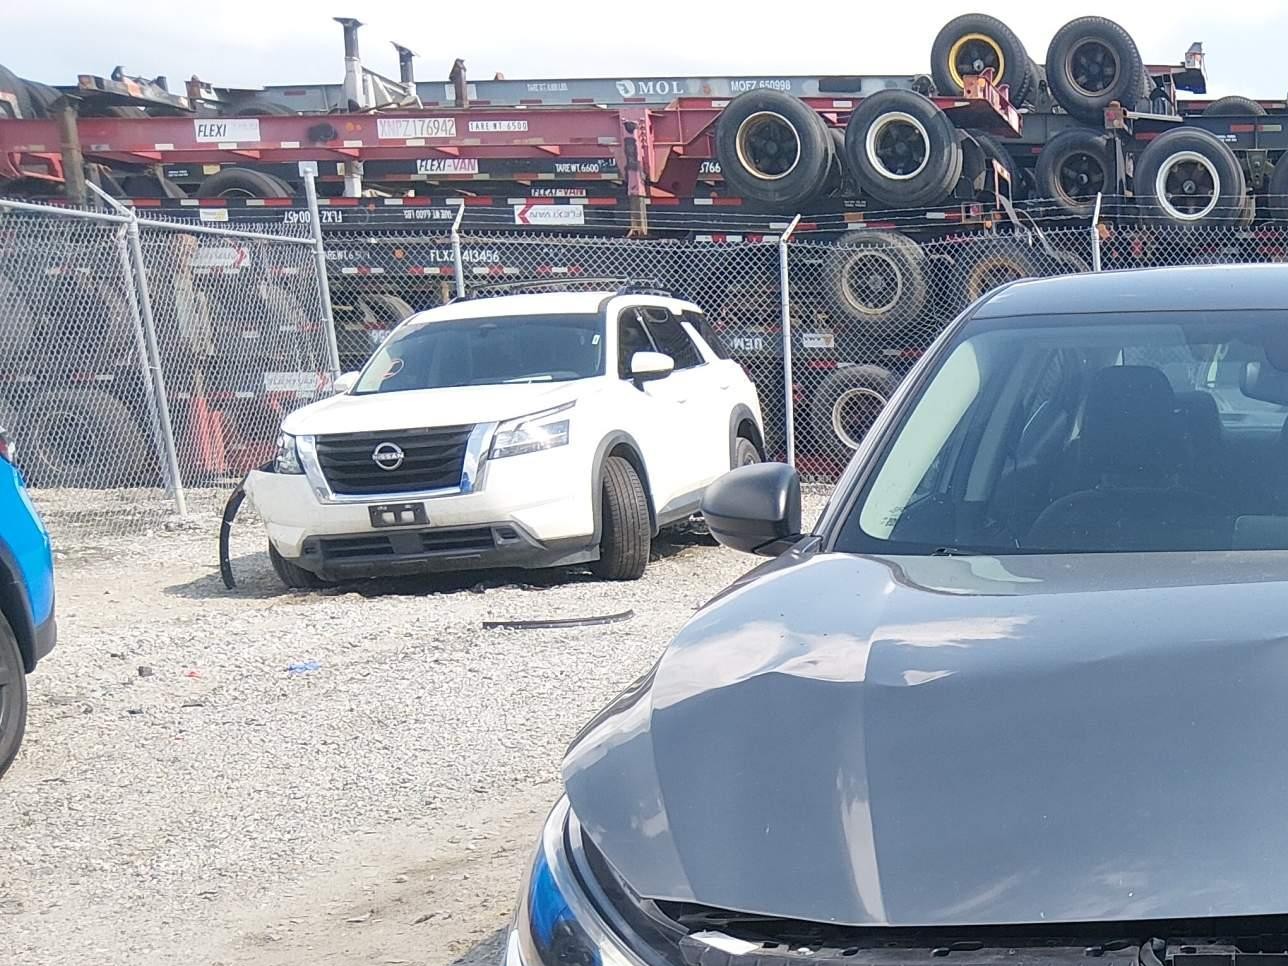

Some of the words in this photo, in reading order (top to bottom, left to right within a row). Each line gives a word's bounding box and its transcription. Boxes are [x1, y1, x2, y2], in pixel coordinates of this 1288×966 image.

[638, 81, 684, 94] MOL
[198, 124, 227, 137] FLEXI
[418, 160, 476, 172] FLEXI-VAN
[284, 211, 311, 223] 00457
[321, 211, 343, 223] FLXZ
